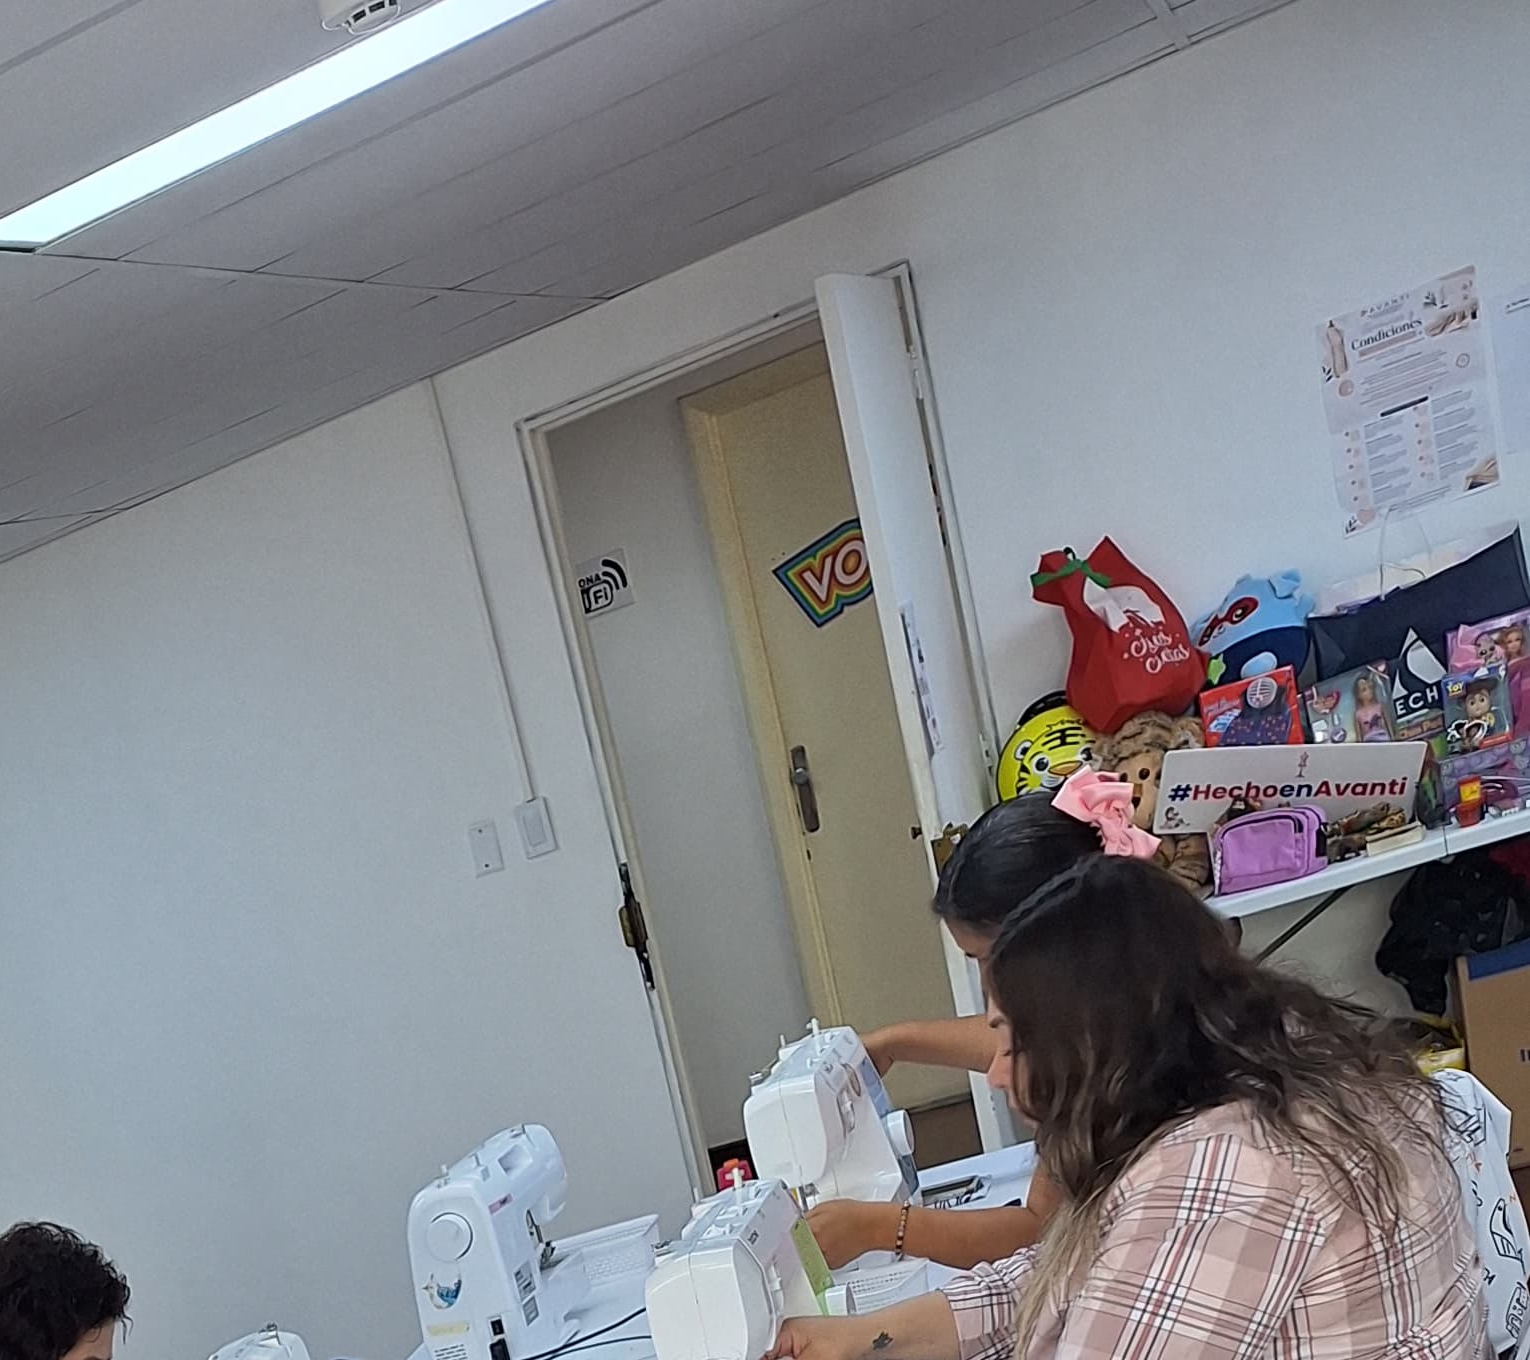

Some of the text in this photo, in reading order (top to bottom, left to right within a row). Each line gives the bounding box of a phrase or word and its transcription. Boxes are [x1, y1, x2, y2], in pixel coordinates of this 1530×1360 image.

[1351, 318, 1423, 351] Condiciones
[578, 573, 601, 588] ONA
[1168, 776, 1408, 801] #HechoenAvanti
